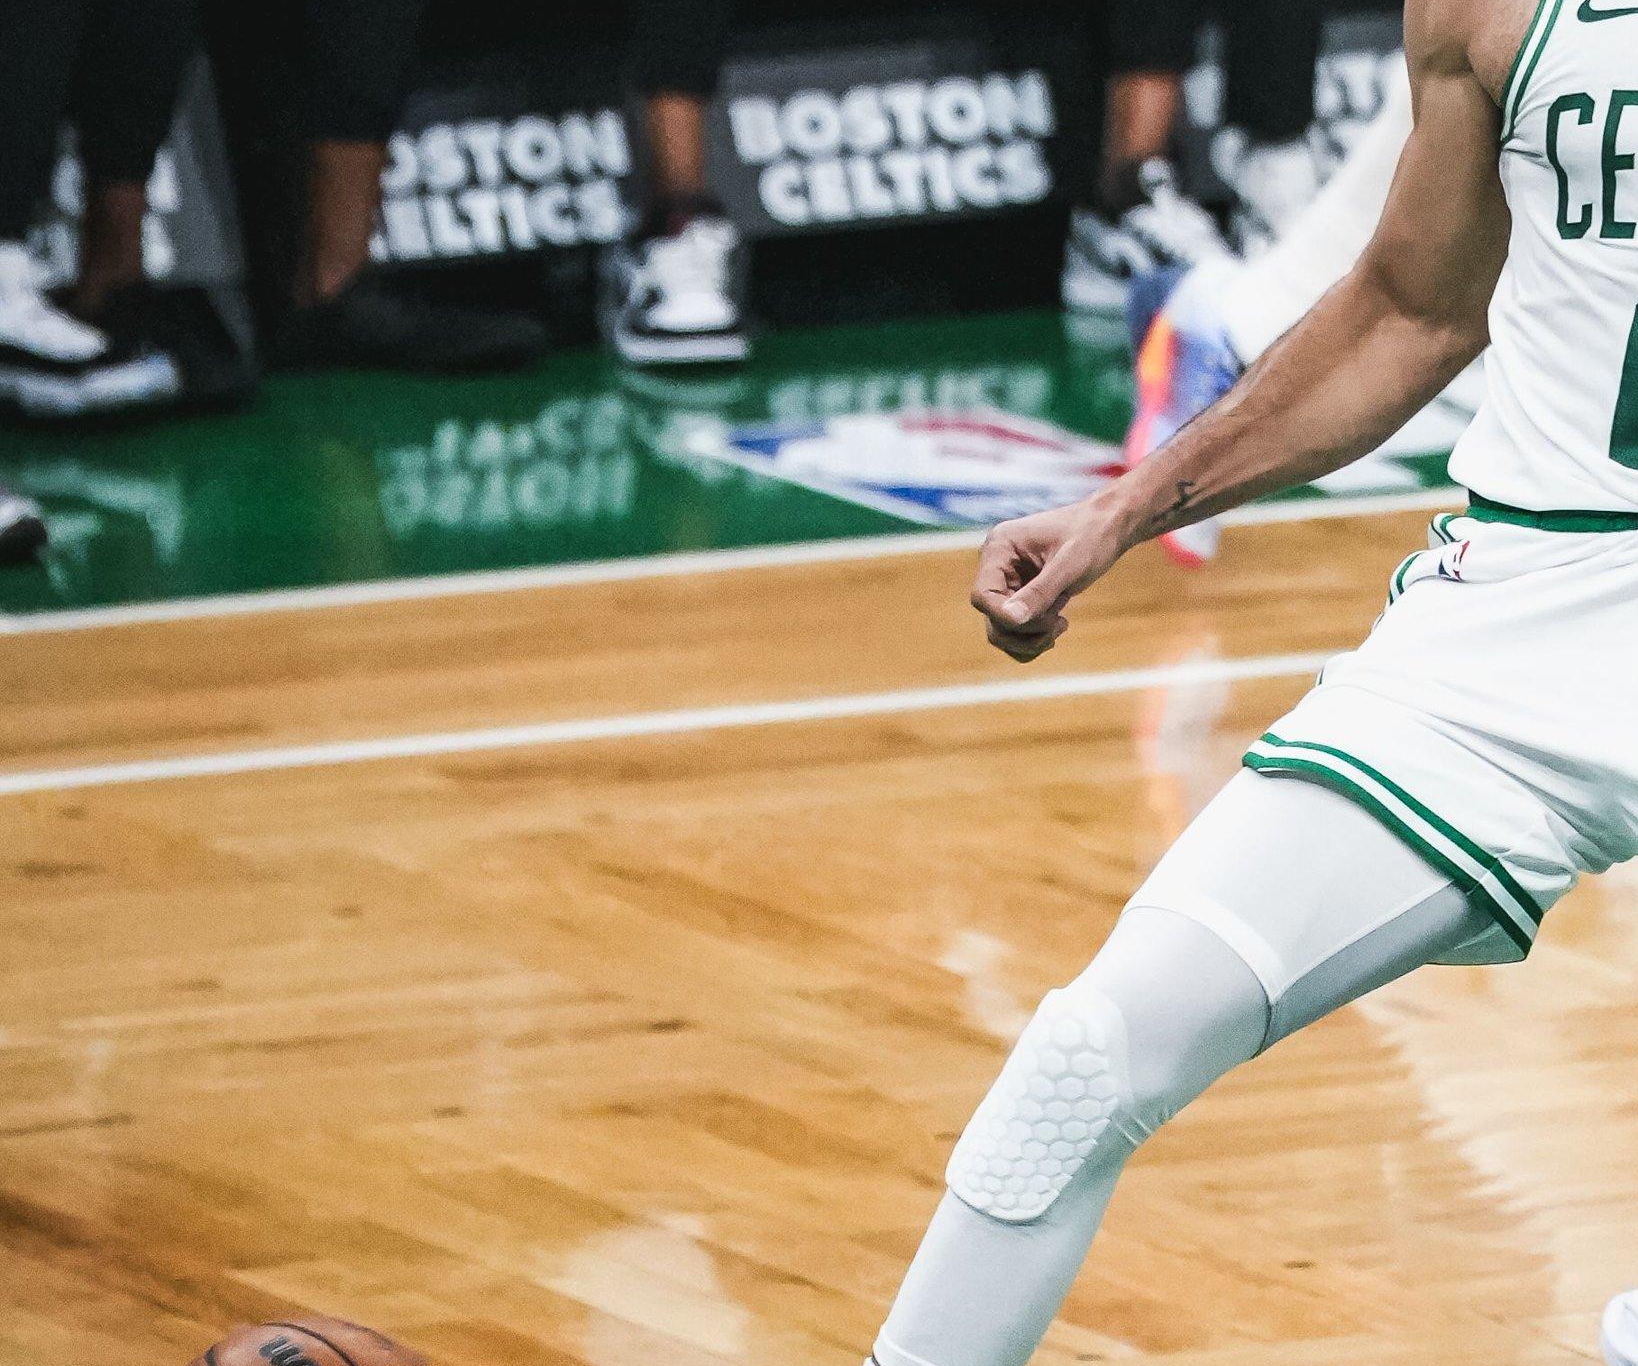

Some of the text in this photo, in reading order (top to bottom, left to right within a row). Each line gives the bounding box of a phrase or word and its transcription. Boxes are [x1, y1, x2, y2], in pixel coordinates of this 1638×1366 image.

[727, 68, 1054, 165] BOSTON
[368, 179, 624, 263] ELTICS
[758, 137, 1052, 226] CELTICS
